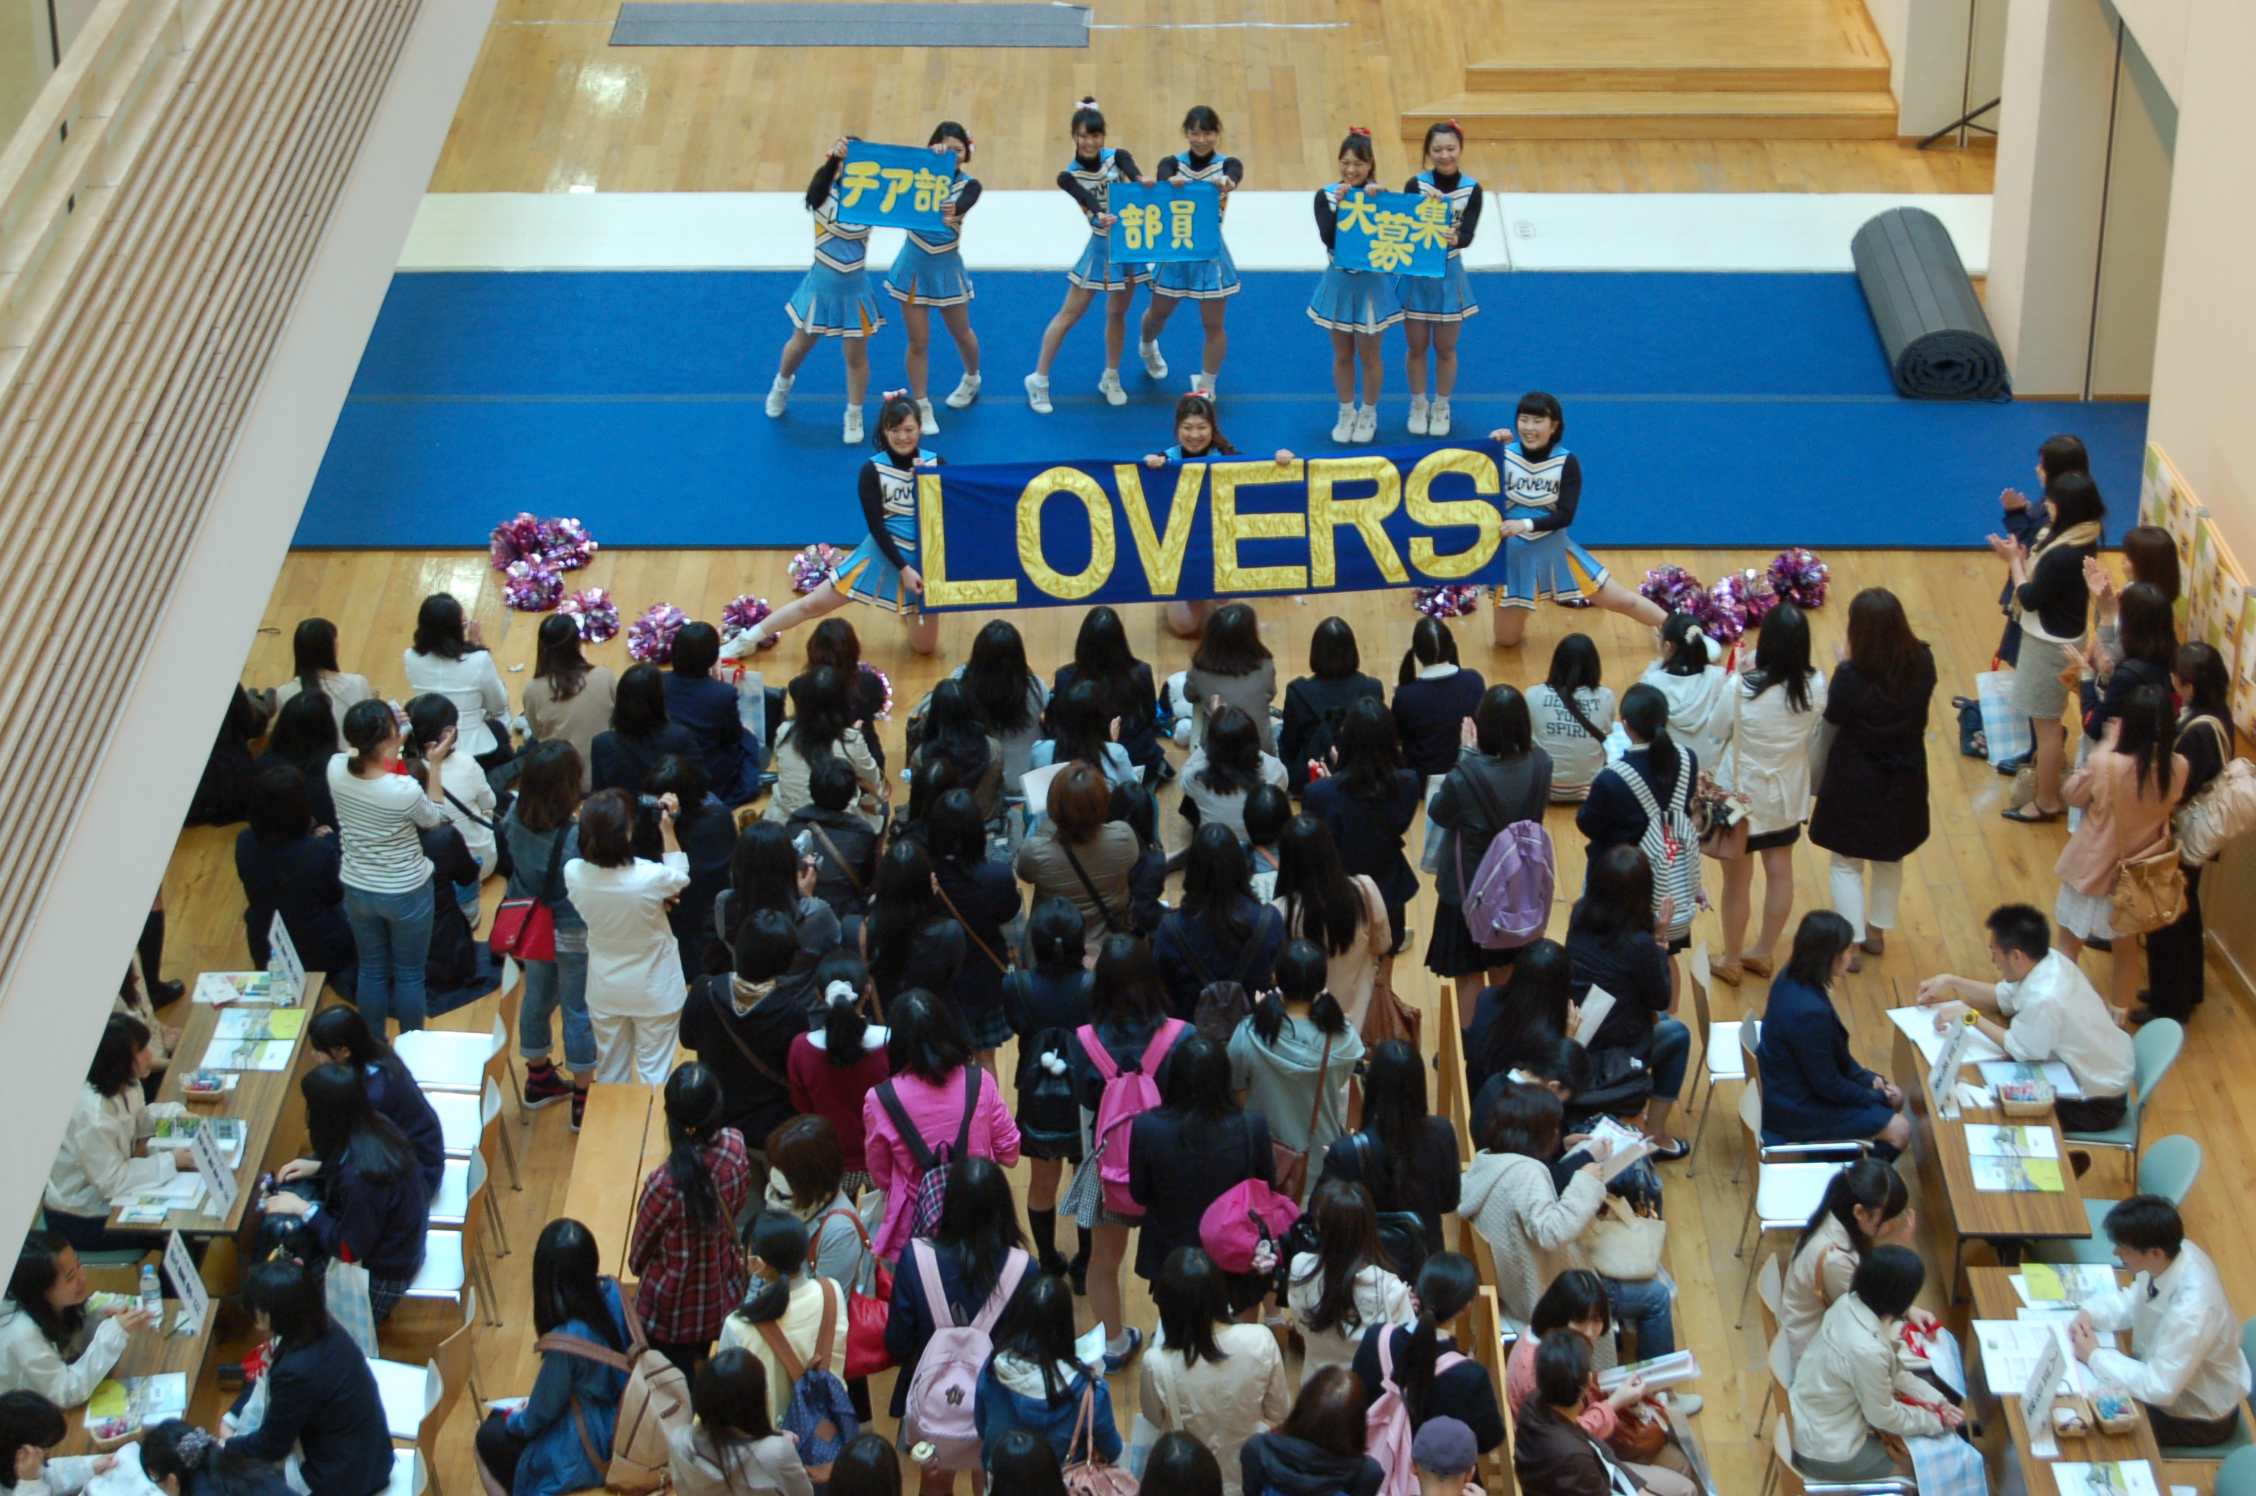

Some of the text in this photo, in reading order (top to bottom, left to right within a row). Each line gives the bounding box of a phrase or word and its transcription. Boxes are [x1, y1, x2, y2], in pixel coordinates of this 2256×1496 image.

[842, 161, 952, 213] チア部
[1118, 200, 1196, 250] 部員
[1337, 191, 1451, 271] 大募集
[883, 484, 914, 503] Lov
[1506, 471, 1560, 495] Lovers
[917, 448, 1503, 607] LOVERS
[1546, 722, 1593, 738] SPIRI
